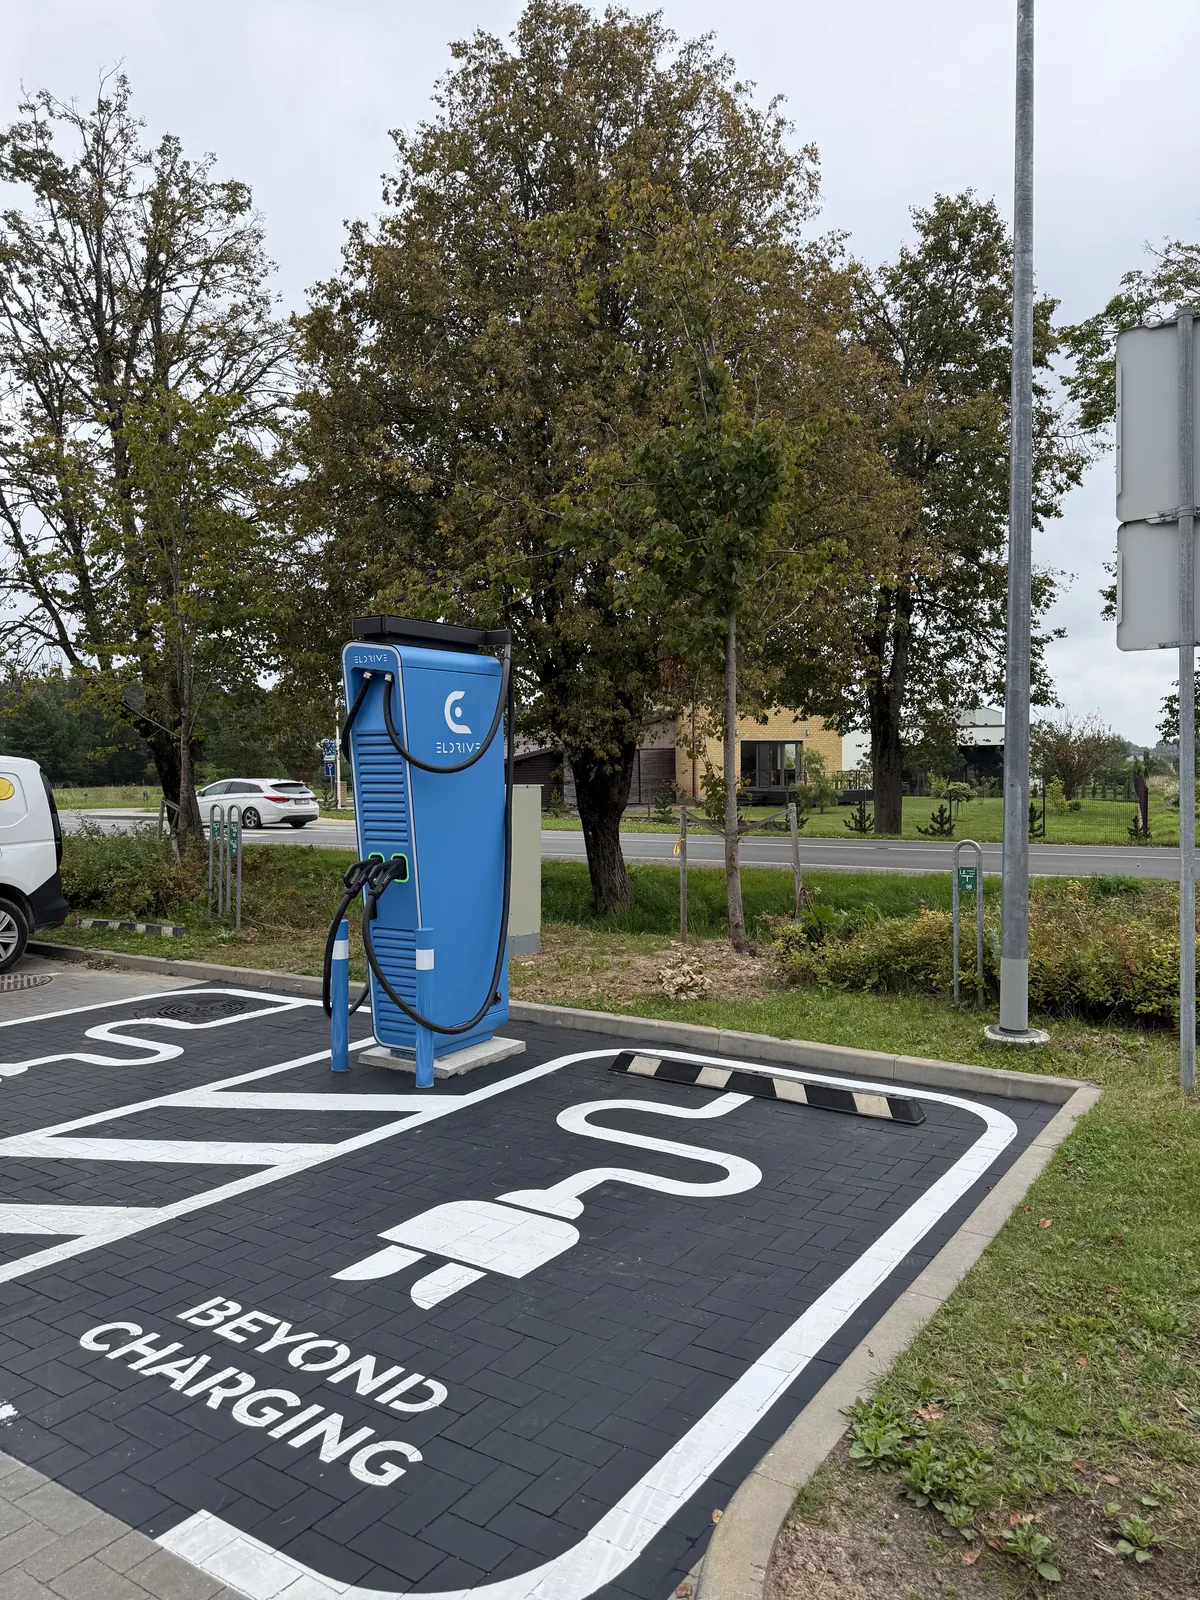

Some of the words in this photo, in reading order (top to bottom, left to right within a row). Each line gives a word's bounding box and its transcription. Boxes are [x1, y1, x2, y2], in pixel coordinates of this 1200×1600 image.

[354, 653, 388, 664] ELDRIVE
[436, 741, 481, 754] ELDRIVE
[176, 1296, 448, 1412] BEYOND
[79, 1321, 423, 1487] CHARGING
